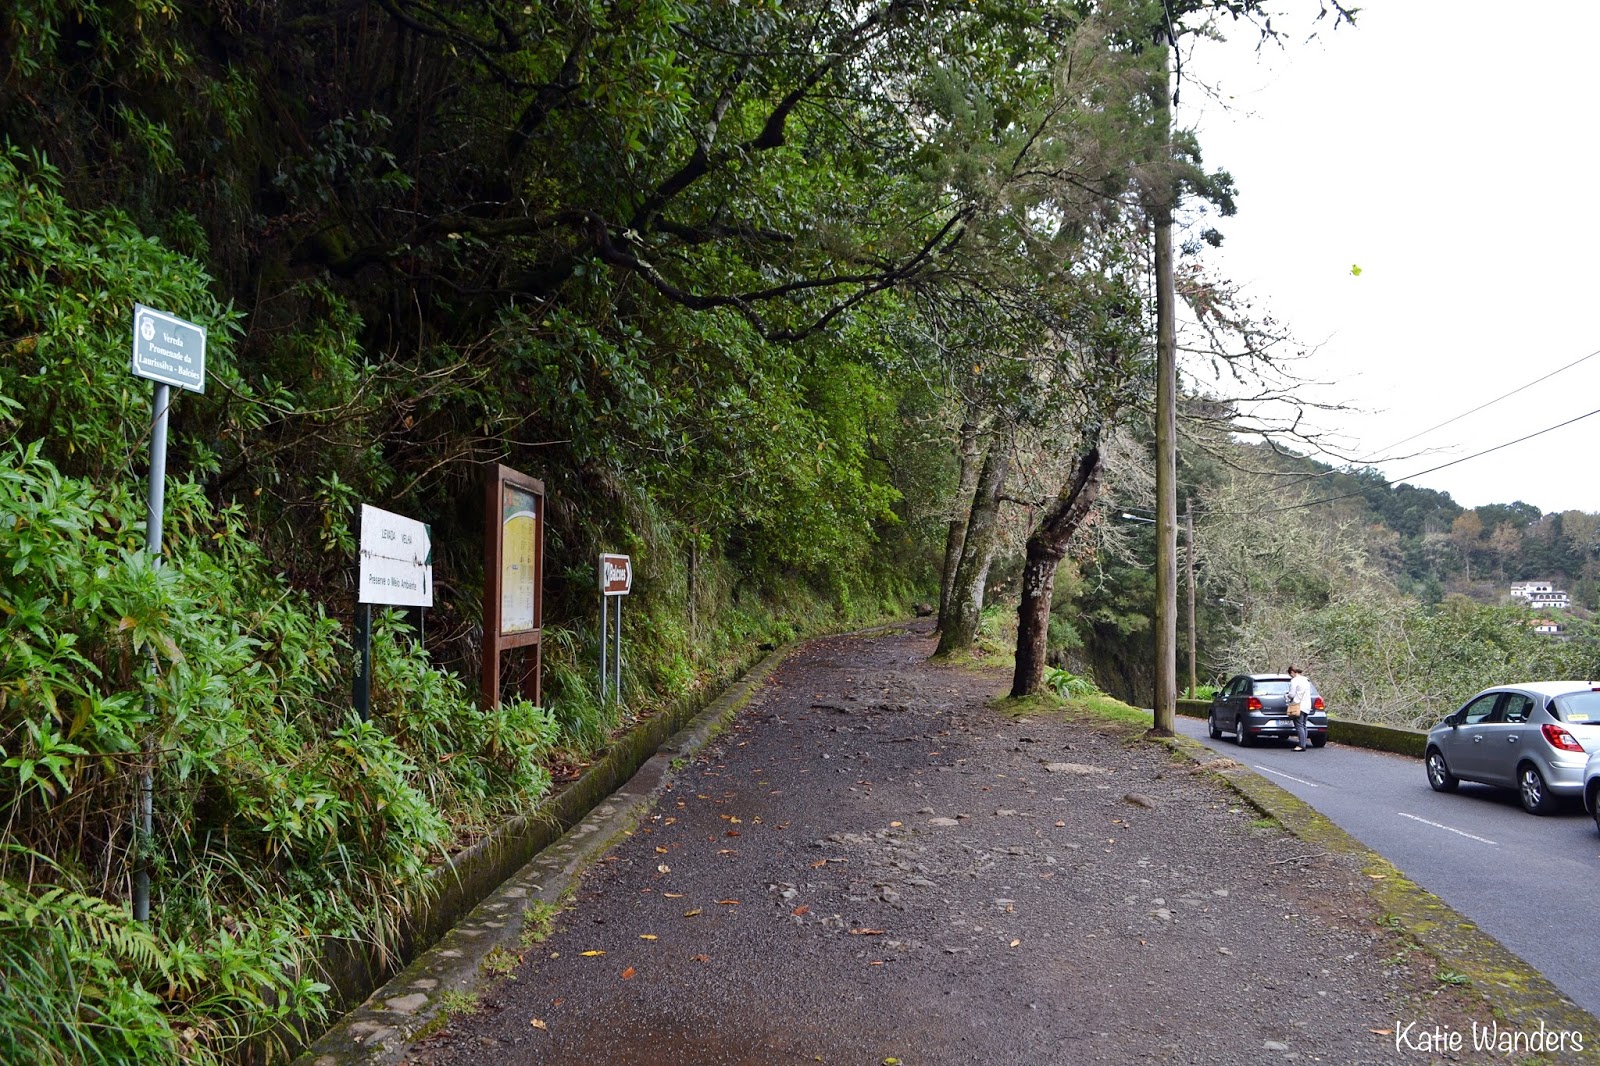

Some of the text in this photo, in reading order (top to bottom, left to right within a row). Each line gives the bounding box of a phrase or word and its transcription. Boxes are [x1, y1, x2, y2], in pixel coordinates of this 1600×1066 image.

[163, 332, 184, 348] Vereda
[149, 342, 192, 364] Promenade da
[138, 353, 174, 372] Laurissilva
[178, 365, 200, 380] Balcões
[368, 573, 386, 586] Preserve
